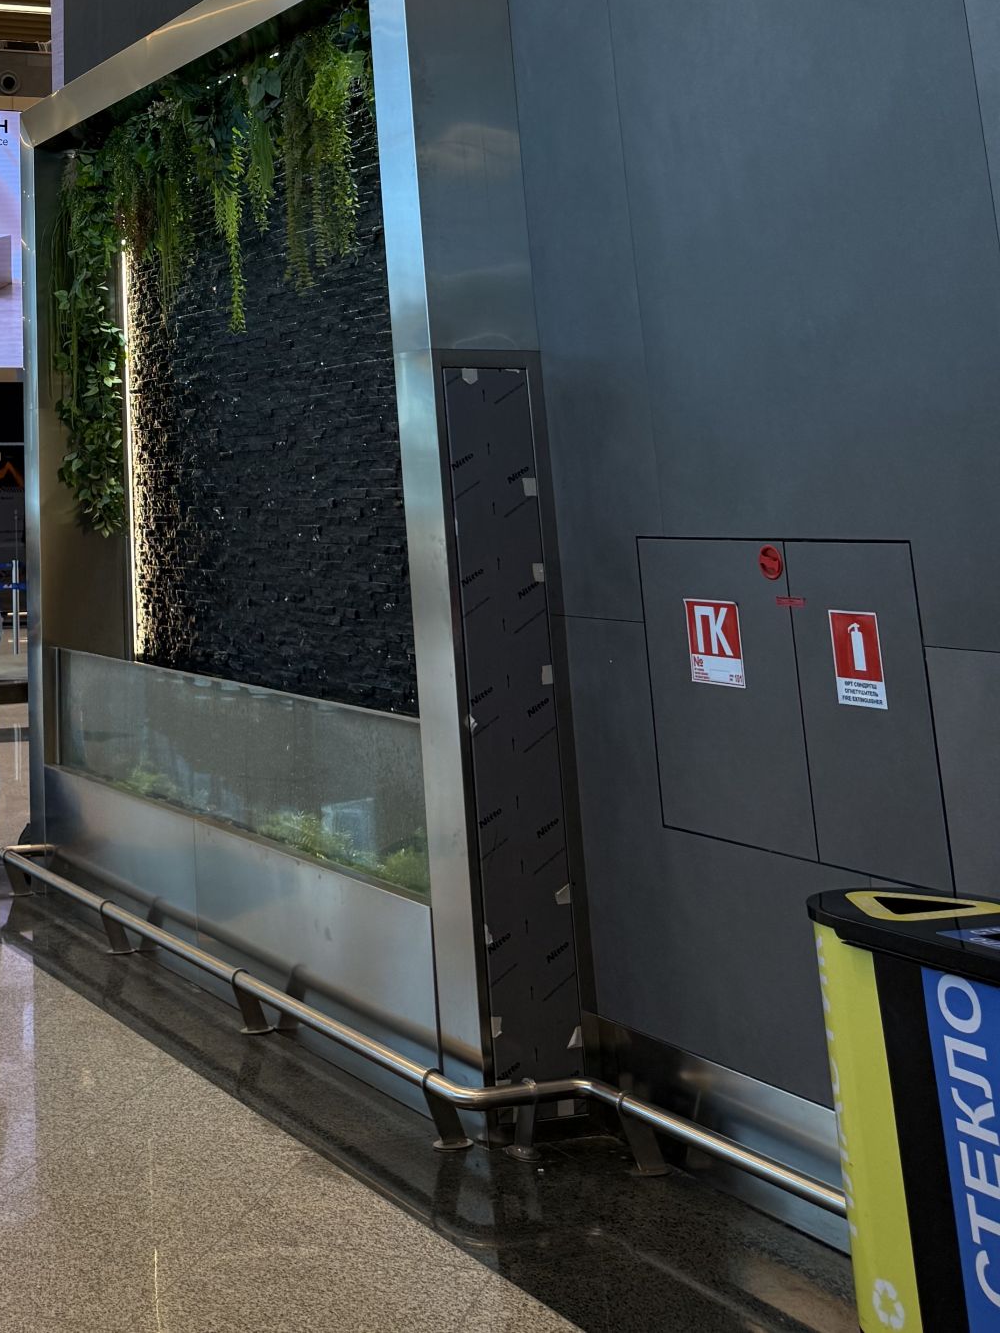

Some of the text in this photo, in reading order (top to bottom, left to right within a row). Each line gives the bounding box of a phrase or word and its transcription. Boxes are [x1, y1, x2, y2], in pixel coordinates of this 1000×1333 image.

[461, 568, 484, 587] Nitto
[517, 580, 540, 600] Nitto
[693, 605, 734, 657] ПК
[470, 686, 493, 707] Nitto
[527, 697, 550, 718] Nitto
[478, 808, 502, 829] Nitto
[536, 817, 560, 839] Nitto
[487, 932, 512, 955] Nitto
[545, 941, 570, 964] Nitto
